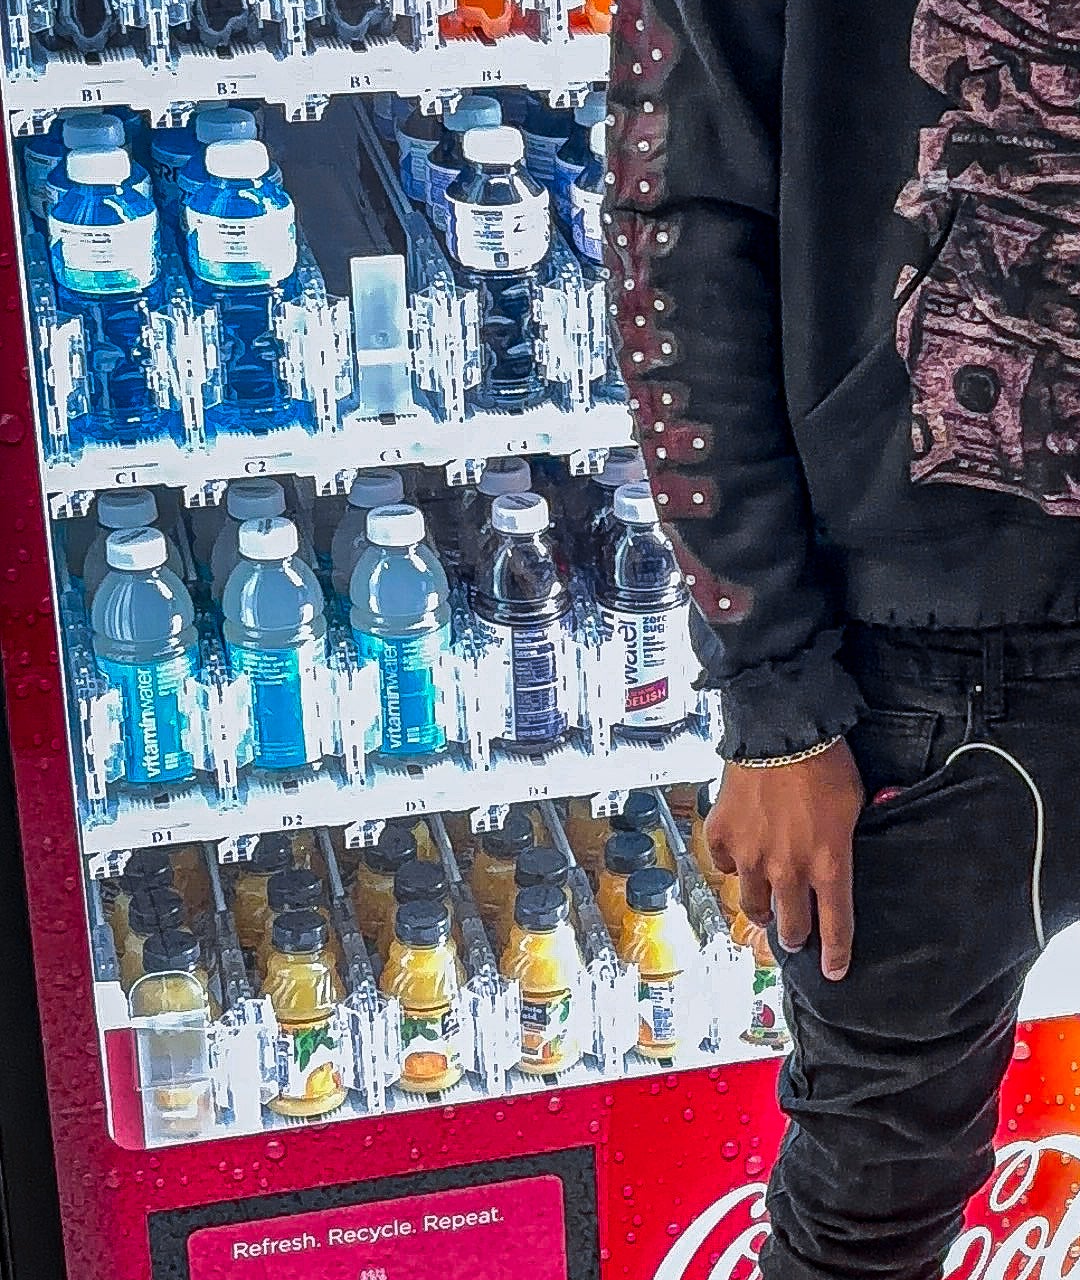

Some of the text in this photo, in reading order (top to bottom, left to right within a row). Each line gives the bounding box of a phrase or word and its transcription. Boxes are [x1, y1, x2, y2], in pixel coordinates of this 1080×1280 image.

[81, 88, 102, 102] B1
[216, 82, 238, 95] B2
[244, 460, 267, 474] C2
[115, 471, 137, 484] C1
[137, 668, 161, 778] vitaminwater
[282, 814, 303, 827] D2
[151, 830, 173, 843] D1
[232, 1206, 505, 1260] Refresh. Recycle. Repeat.
